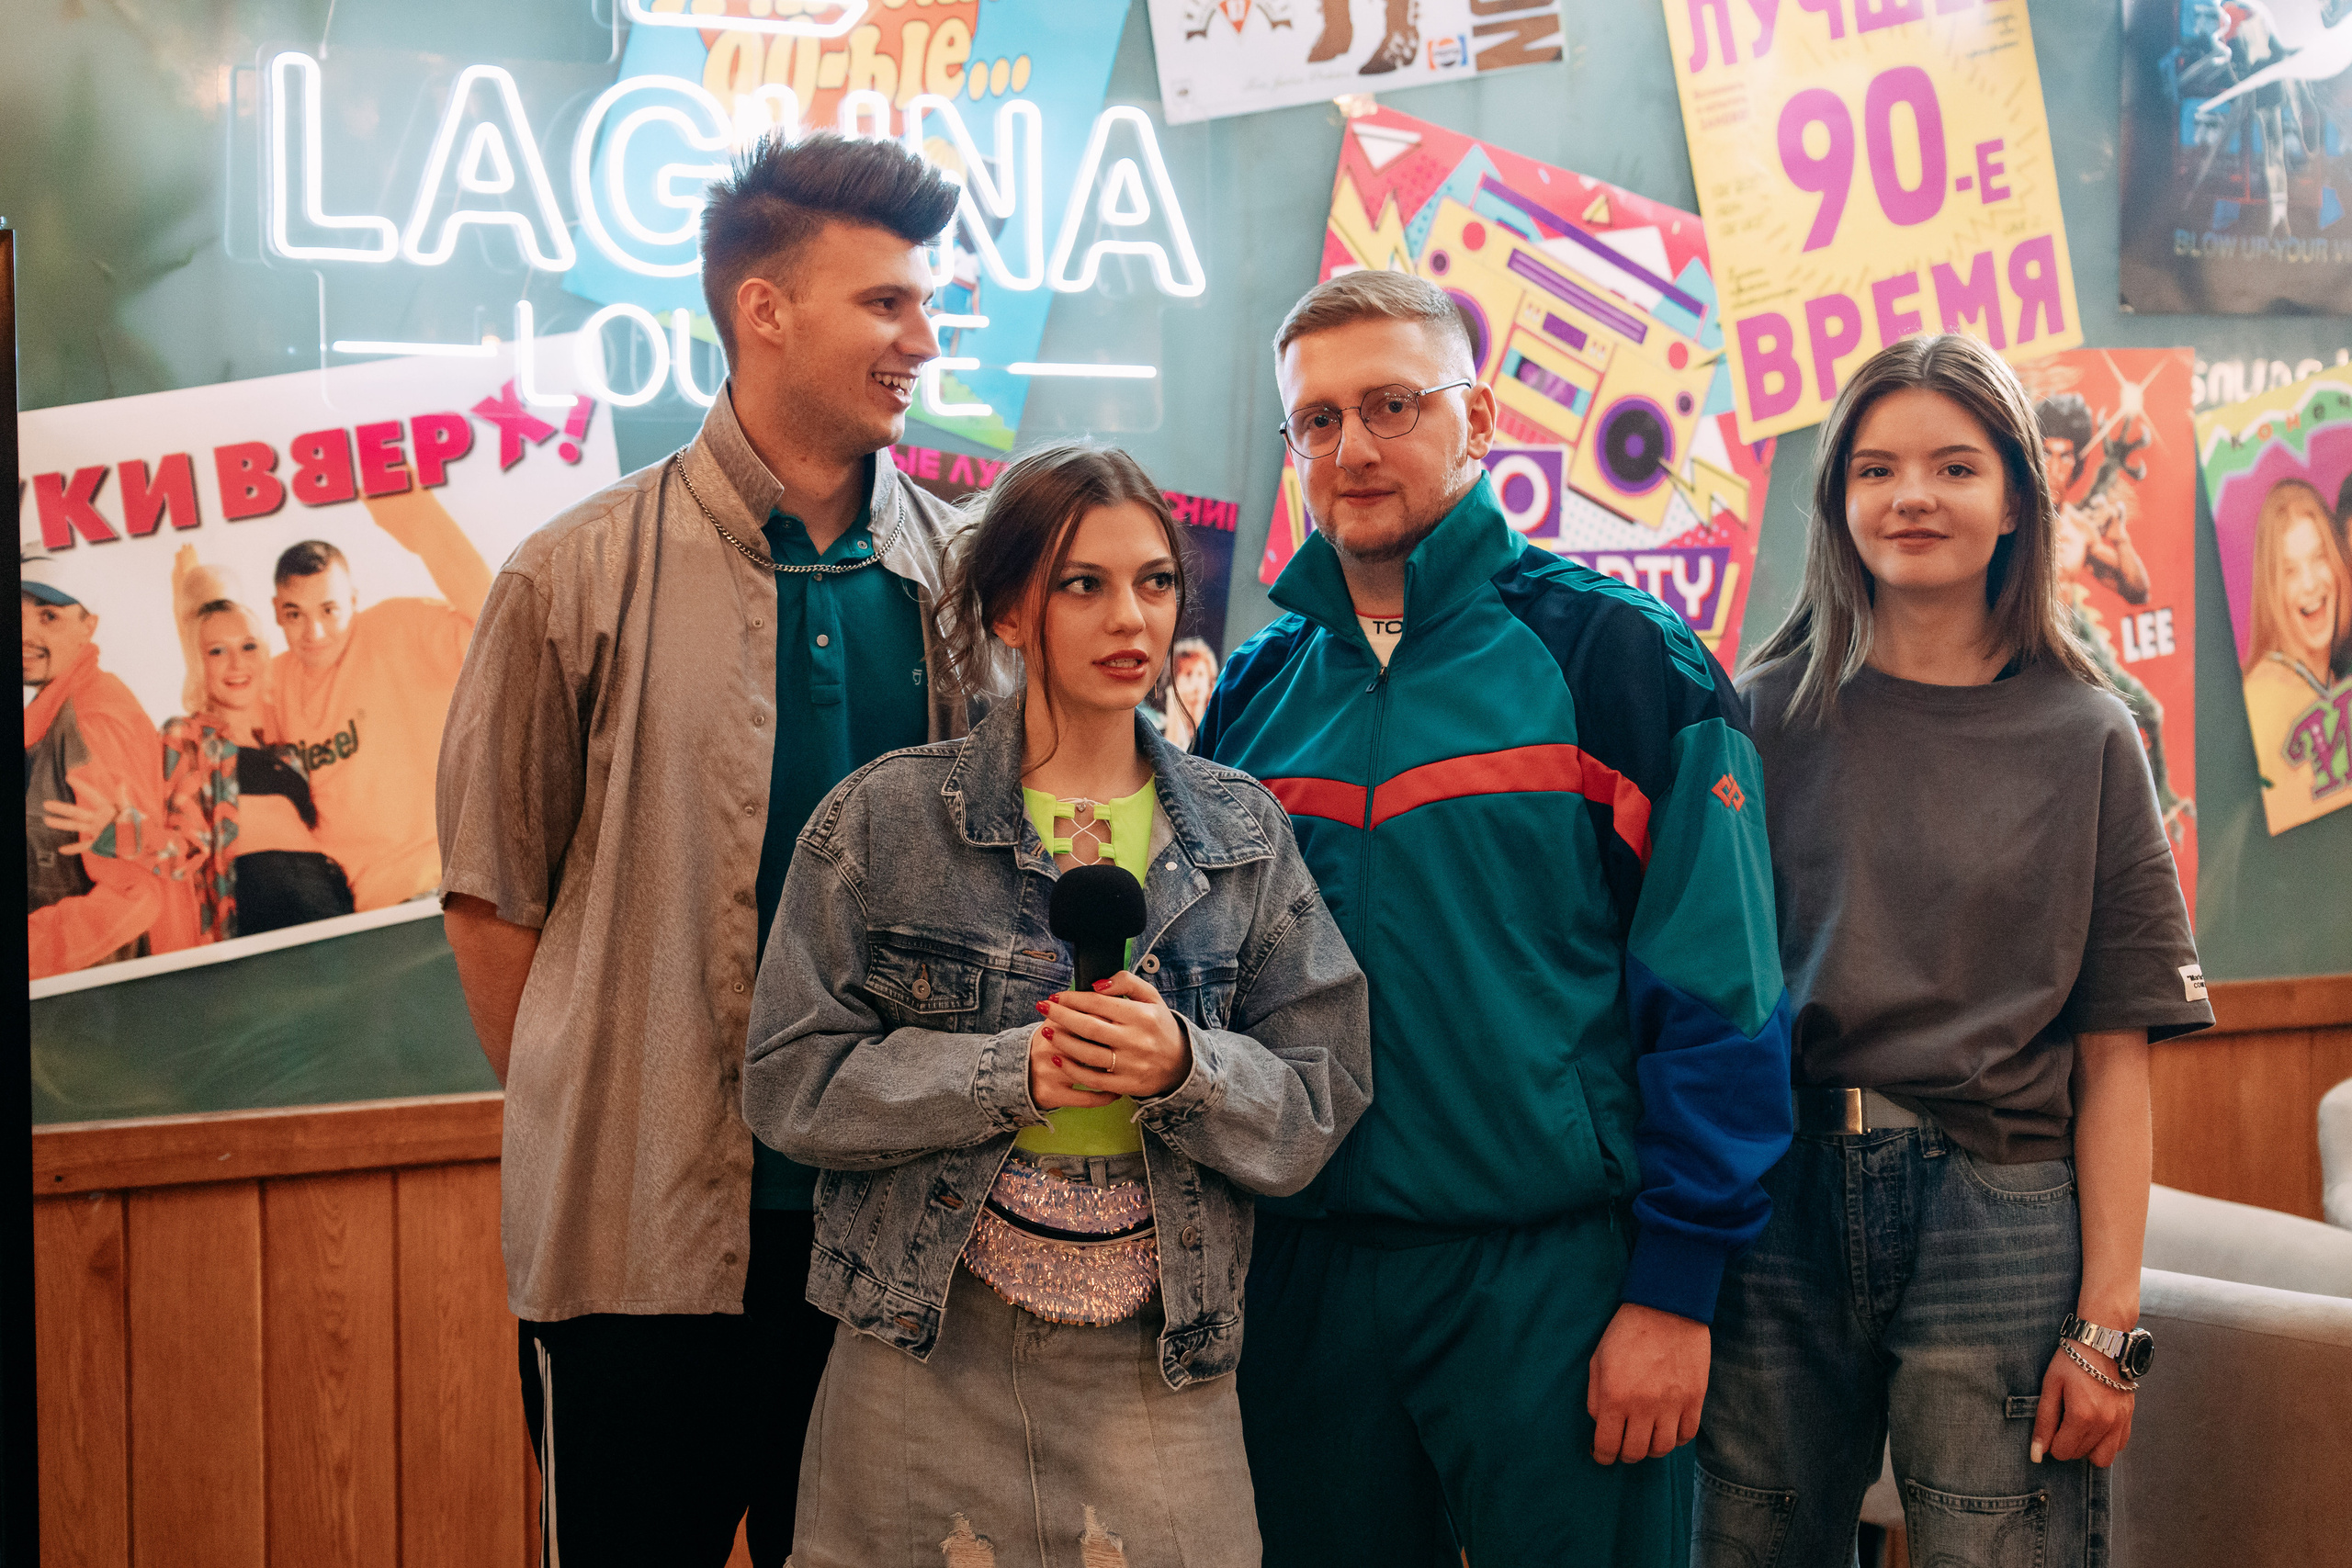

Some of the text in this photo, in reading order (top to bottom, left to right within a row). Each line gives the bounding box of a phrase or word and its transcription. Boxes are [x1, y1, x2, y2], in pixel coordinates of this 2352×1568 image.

[514, 299, 993, 417] LOUE
[1736, 234, 2066, 423] ВРЕМЯ
[19, 453, 201, 552] КИ
[2121, 607, 2176, 664] LEE
